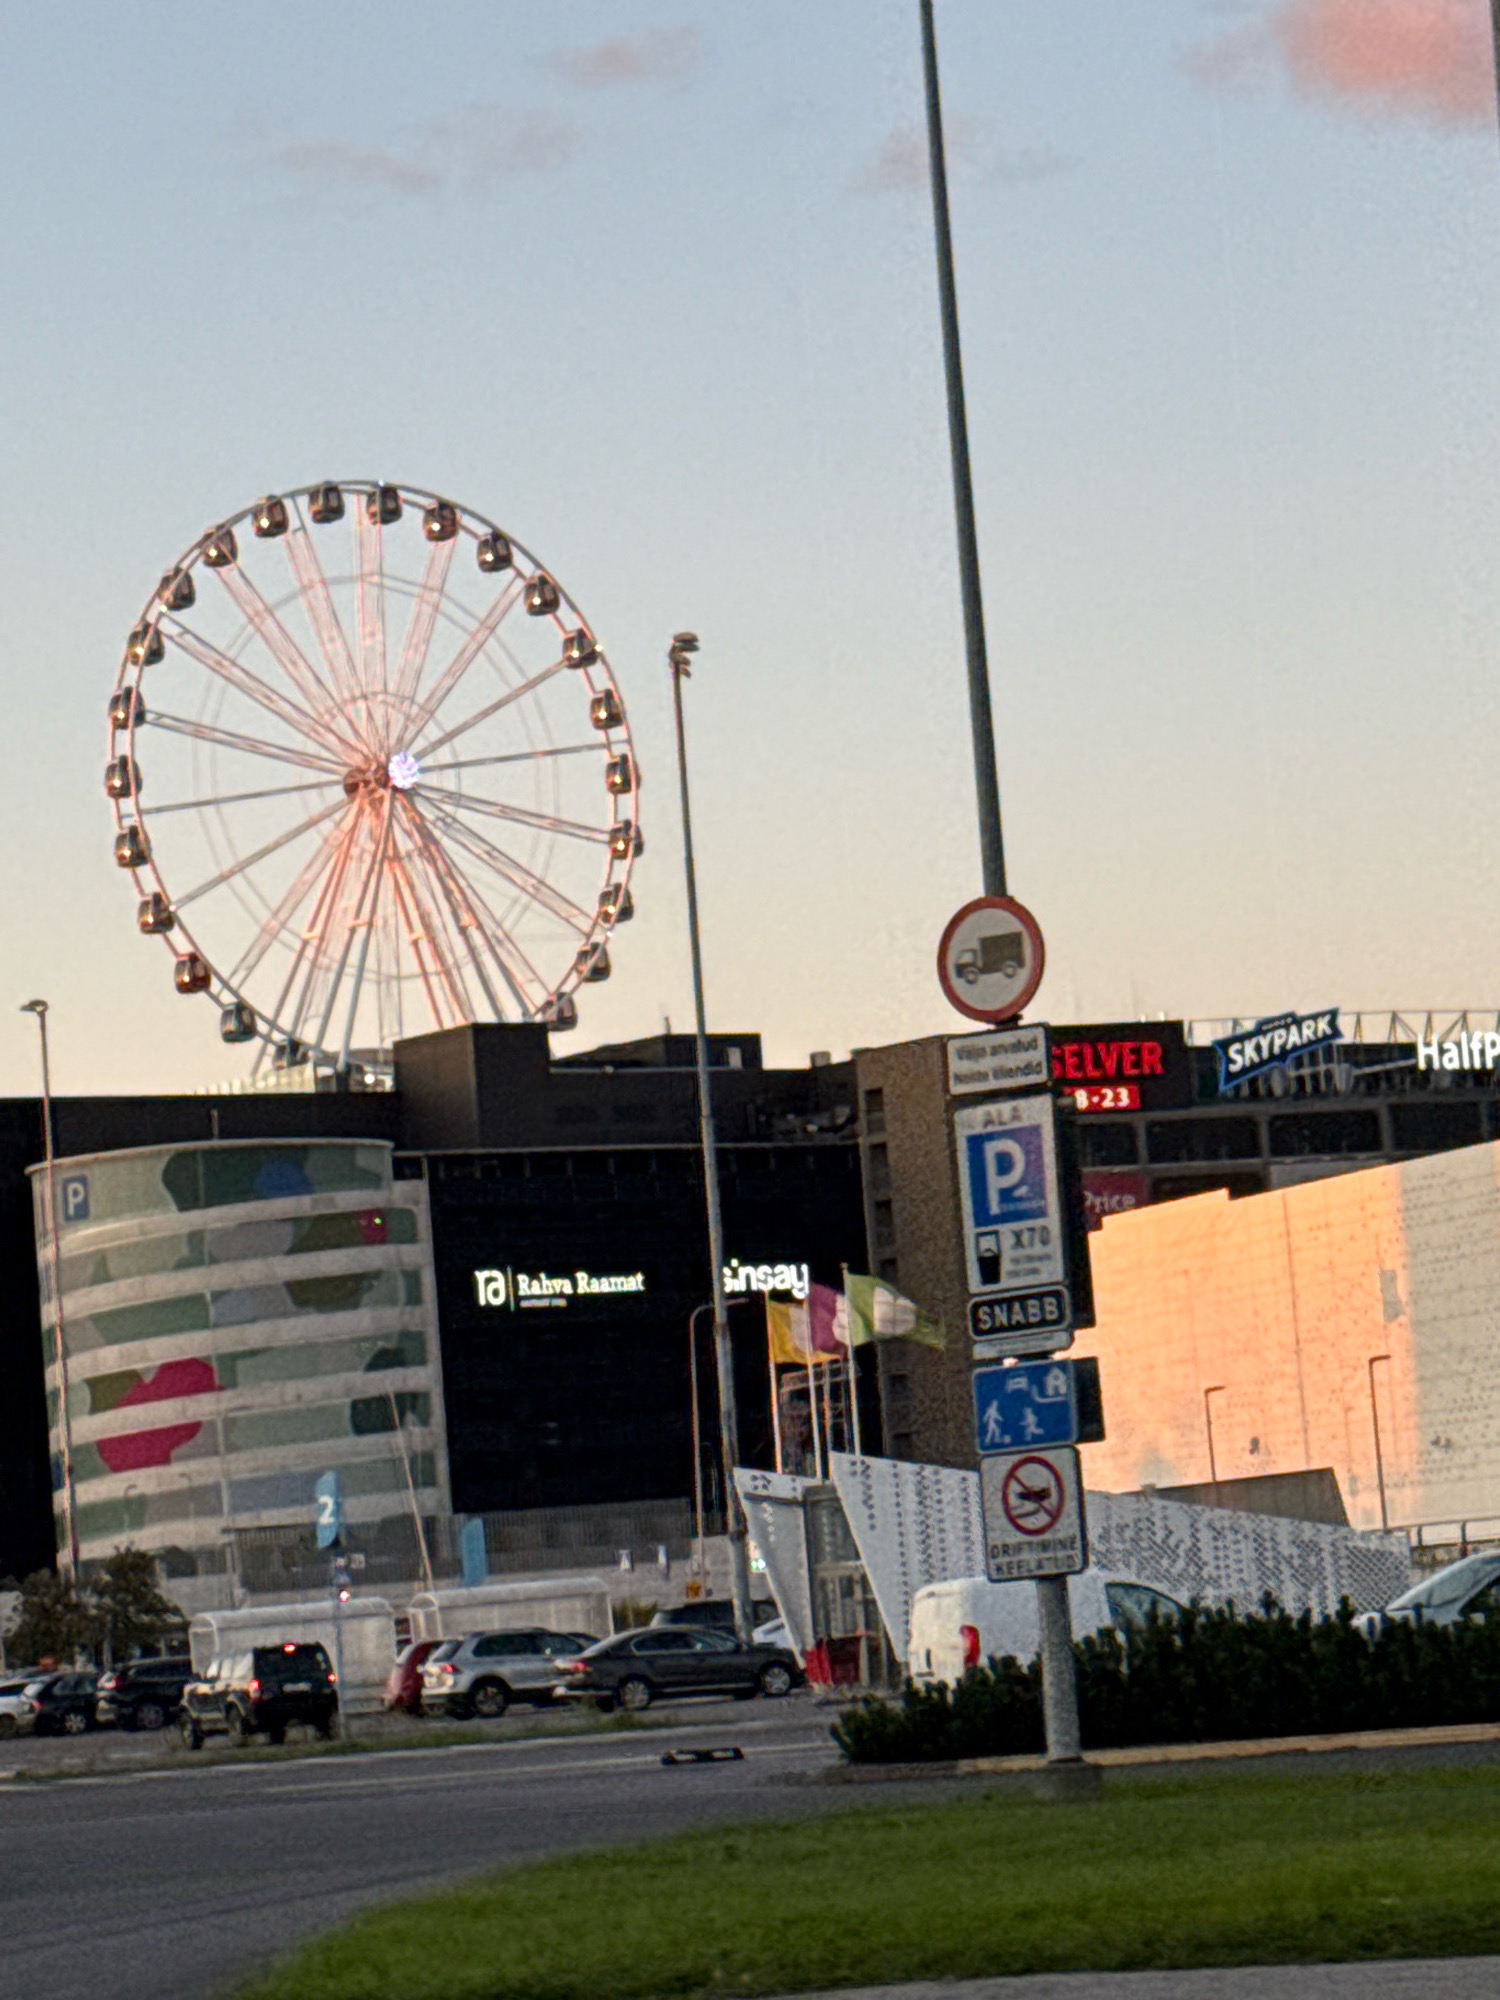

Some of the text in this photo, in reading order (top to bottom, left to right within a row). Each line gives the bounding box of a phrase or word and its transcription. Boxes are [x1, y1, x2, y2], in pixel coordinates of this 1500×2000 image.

[1227, 1014, 1333, 1074] SKYPARK
[1416, 1030, 1500, 1070] HalfP
[982, 1104, 1023, 1130] ALA
[983, 1138, 1026, 1216] P
[67, 1183, 85, 1216] P
[1009, 1224, 1051, 1250] X70
[516, 1272, 574, 1297] Rahva
[575, 1270, 646, 1295] Raamat
[977, 1296, 1059, 1330] SNABB
[318, 1495, 335, 1525] 2
[991, 1533, 1078, 1560] DRIFTIMINE
[994, 1553, 1077, 1576] KEELATUD
